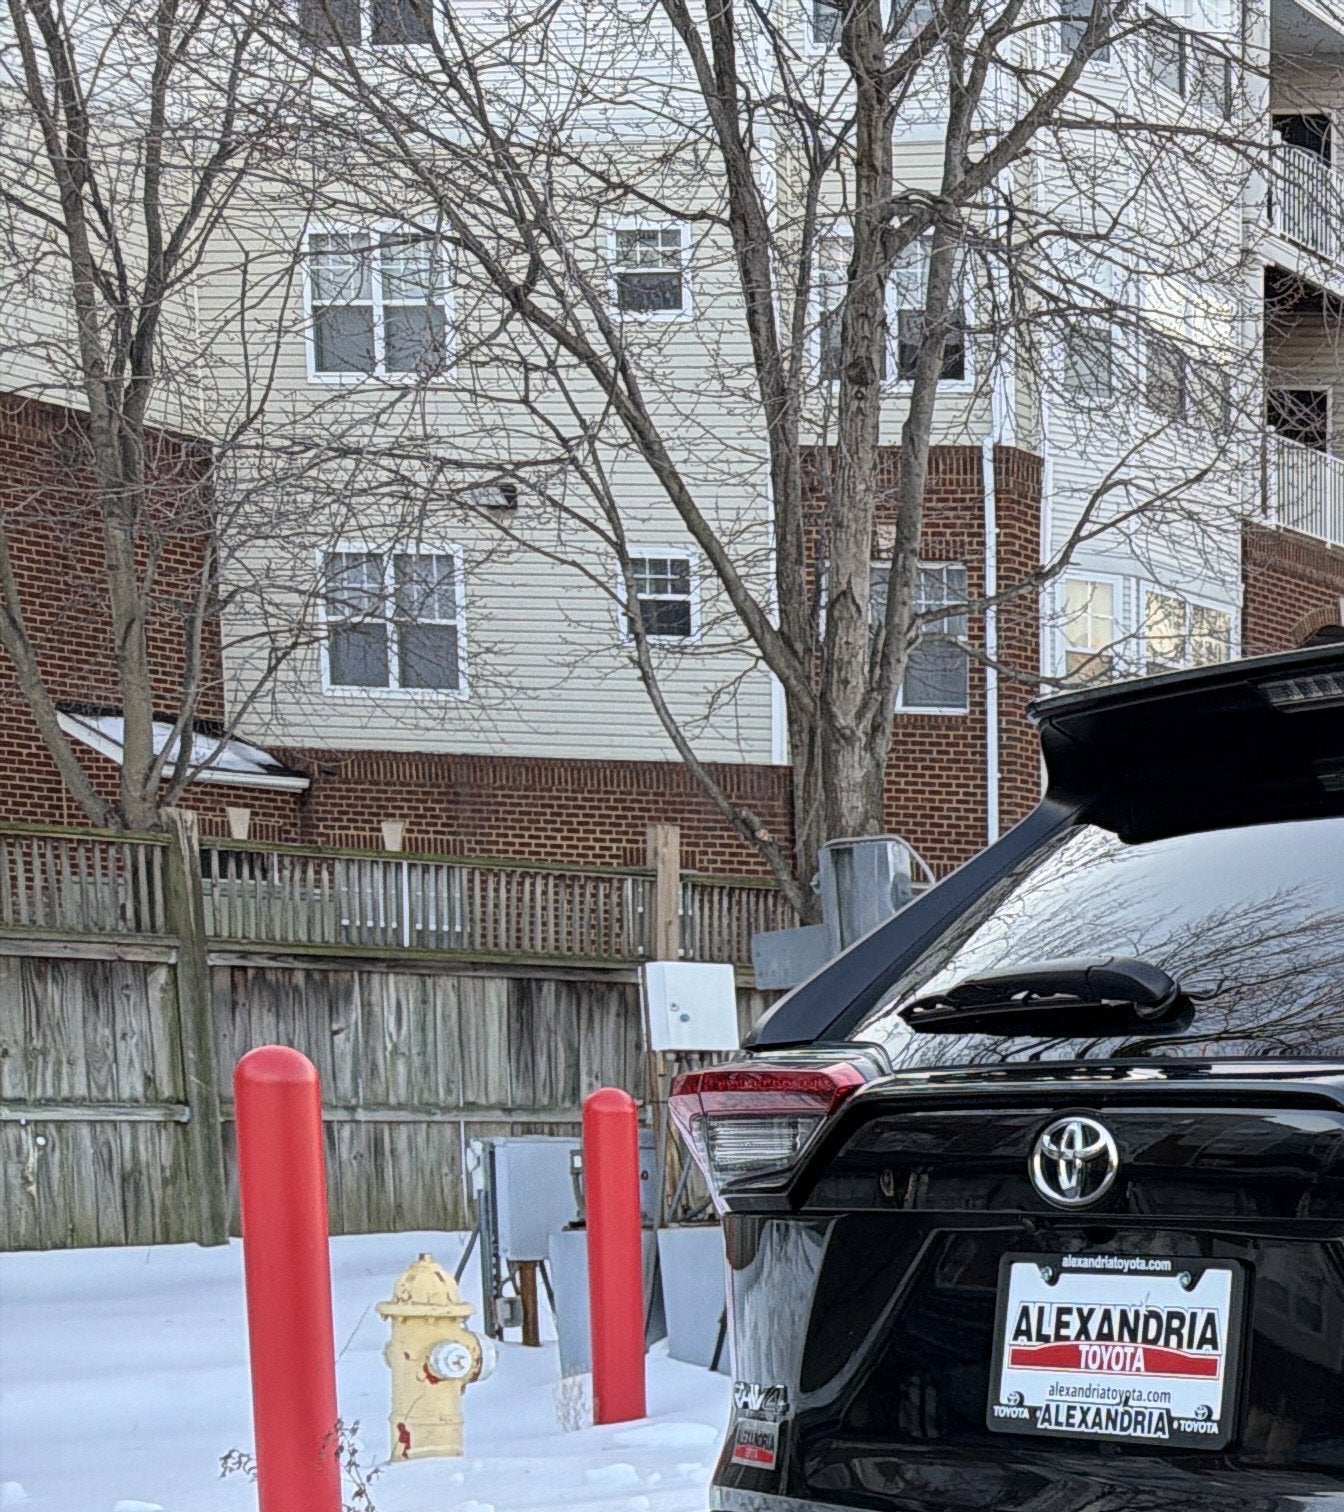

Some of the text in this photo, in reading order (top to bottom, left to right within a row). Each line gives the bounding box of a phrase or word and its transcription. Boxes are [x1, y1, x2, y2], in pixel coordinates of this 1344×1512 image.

[1062, 1255, 1172, 1272] alexandriatoyota.com
[1012, 1305, 1220, 1351] ALEXANDRIA
[1079, 1345, 1146, 1372] TOYOTA
[1048, 1381, 1172, 1404] alexandriatoyota.com
[993, 1406, 1030, 1420] TOYOTA
[1038, 1404, 1169, 1438] ALEXANDRIA
[1179, 1420, 1219, 1434] TOYOTA
